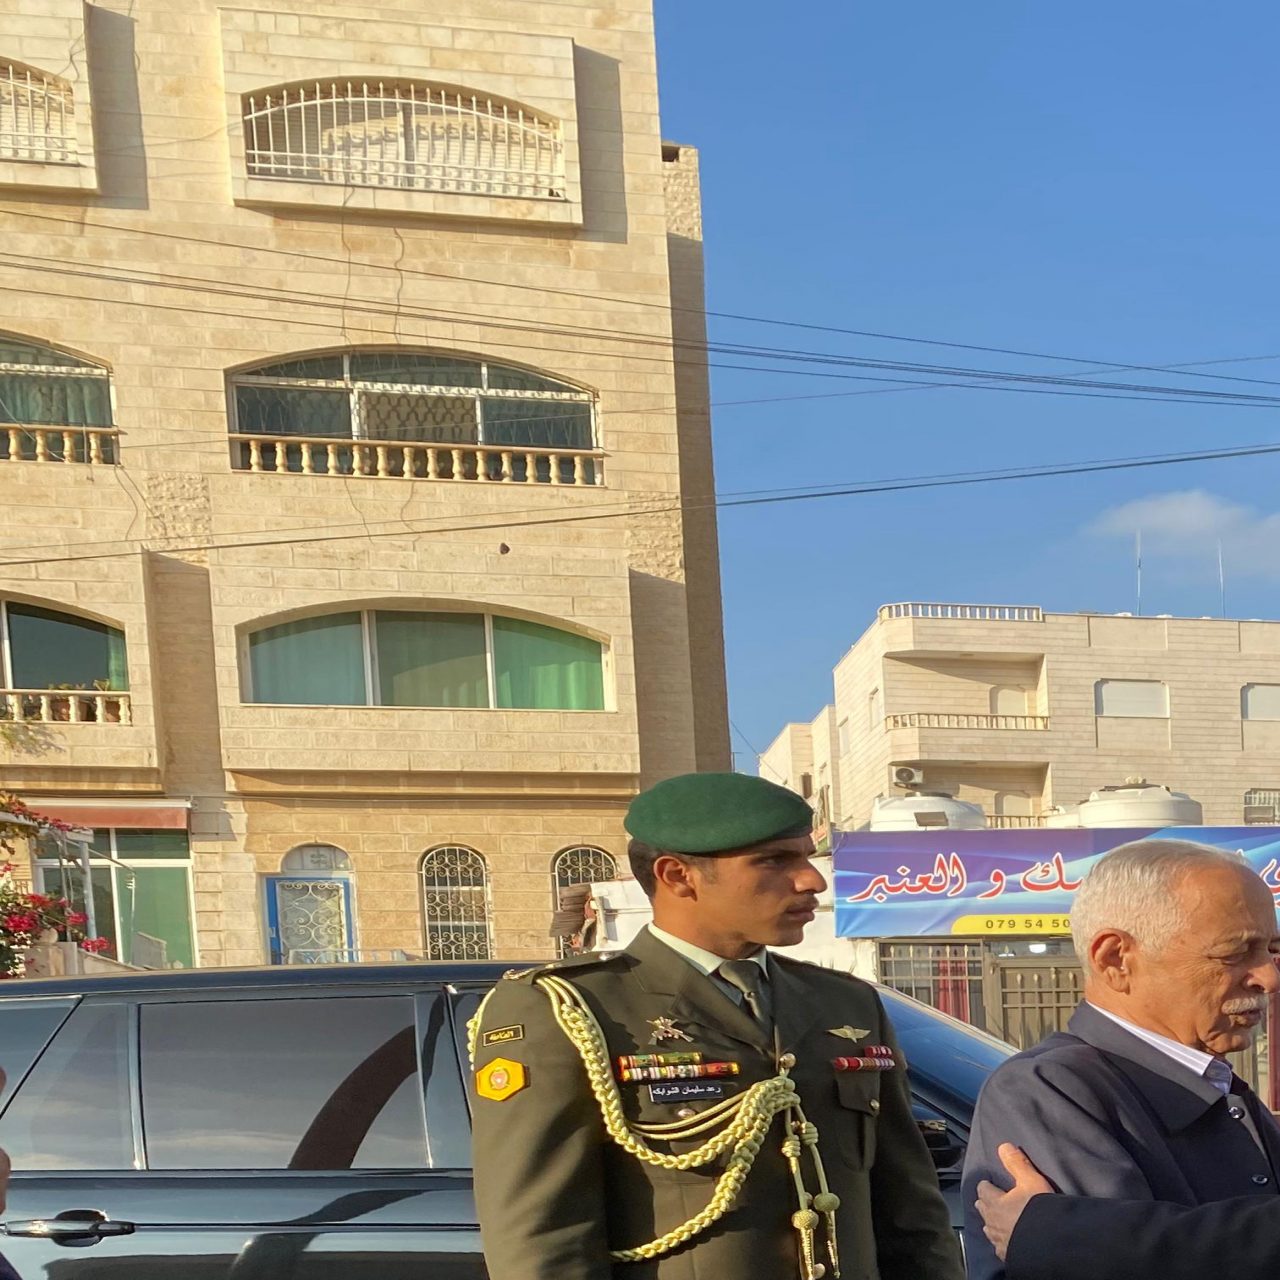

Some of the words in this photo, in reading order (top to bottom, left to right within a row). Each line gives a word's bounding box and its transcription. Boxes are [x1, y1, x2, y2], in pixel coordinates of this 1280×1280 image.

[846, 852, 967, 903] العنبر
[977, 868, 1006, 899] و
[985, 919, 1016, 929] 079
[1024, 919, 1043, 929] 54
